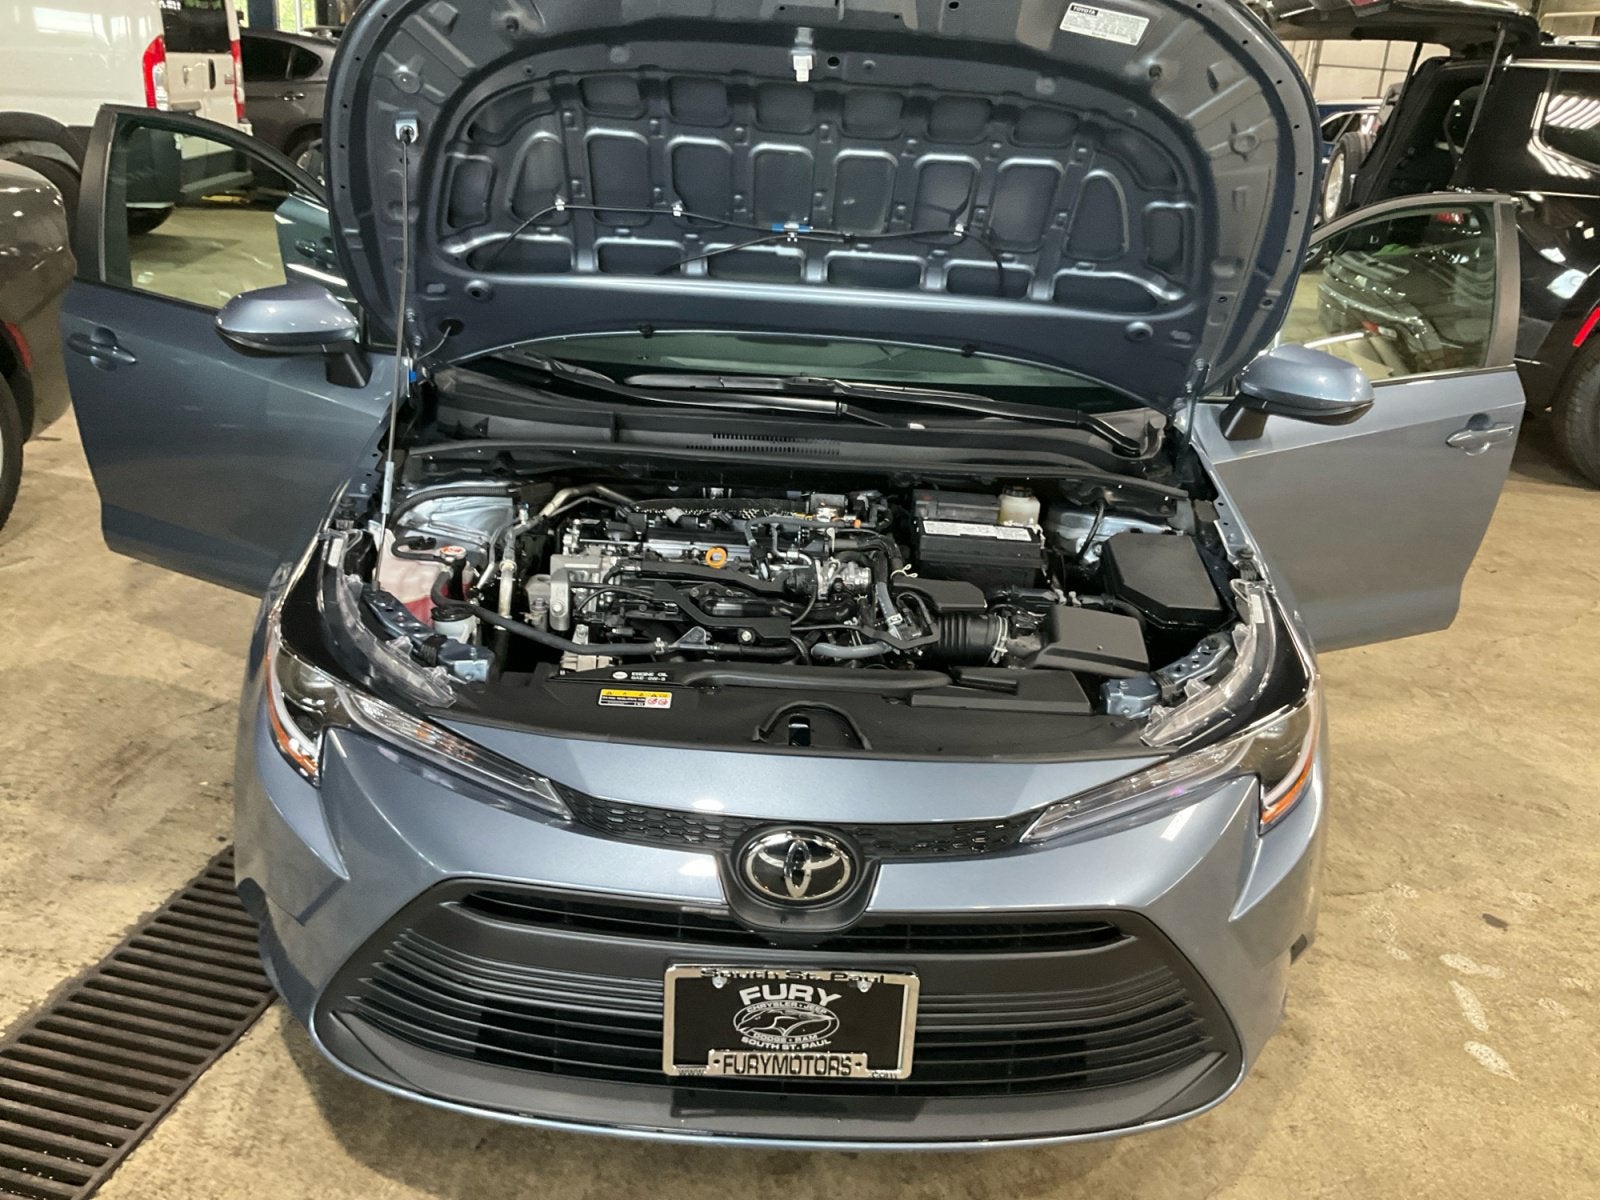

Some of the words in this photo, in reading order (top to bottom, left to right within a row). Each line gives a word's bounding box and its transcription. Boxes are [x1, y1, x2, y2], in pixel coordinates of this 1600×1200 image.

[739, 983, 842, 1006] FURY
[741, 1036, 780, 1050] SOUTH
[801, 1038, 832, 1049] PAUL
[794, 1033, 818, 1044] RAM
